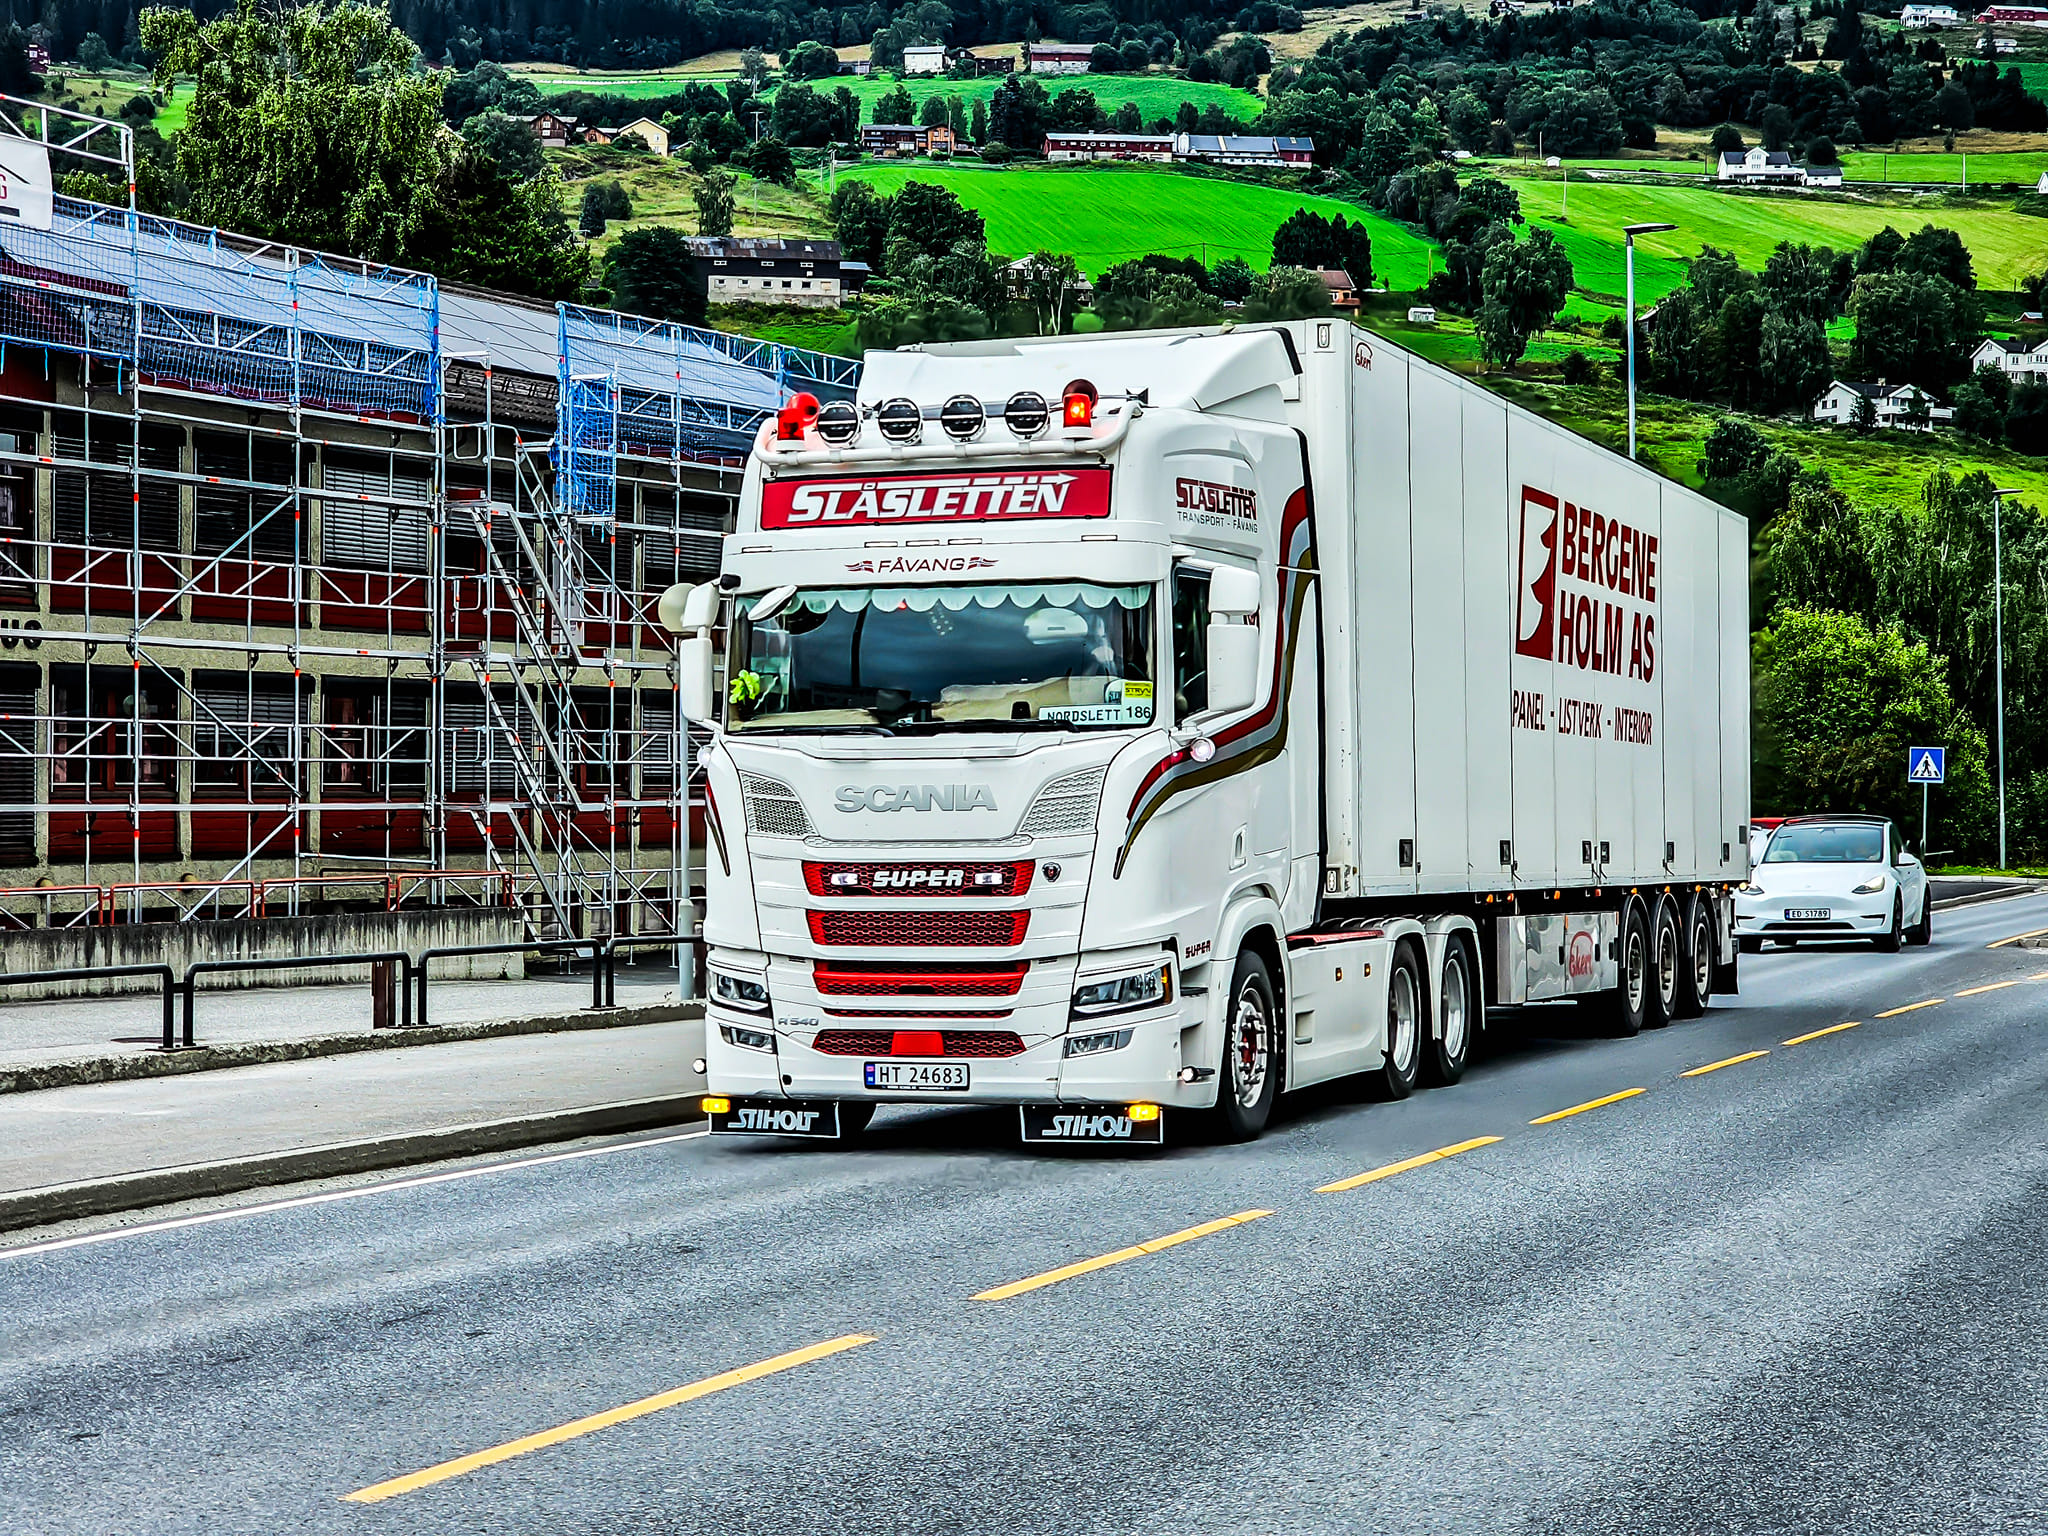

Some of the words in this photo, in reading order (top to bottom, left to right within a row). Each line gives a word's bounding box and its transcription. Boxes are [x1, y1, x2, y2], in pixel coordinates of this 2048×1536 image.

[787, 473, 1077, 522] SLÅSLETTEN
[1176, 477, 1257, 520] SLÅSLETTEN
[1177, 511, 1224, 527] TRANSPORT
[1233, 518, 1258, 533] FÅVANG
[1562, 501, 1658, 603] BERGENE
[878, 557, 966, 574] FÅVANG
[1558, 590, 1623, 676] HOLM
[1629, 612, 1655, 684] AS
[1047, 709, 1120, 722] NORDSLETT
[1126, 706, 1151, 719] 186
[1512, 690, 1545, 731] PANEL
[1558, 697, 1603, 739] LISTVERK
[1614, 707, 1652, 745] INTERIØR
[834, 784, 999, 812] SCANIA
[872, 869, 964, 888] SUPER
[1185, 939, 1211, 959] SUPER
[778, 1017, 788, 1026] R
[790, 1017, 819, 1026] 540
[879, 1066, 901, 1083] HT
[909, 1067, 963, 1084] 24683
[727, 1108, 820, 1132] STIHOLT
